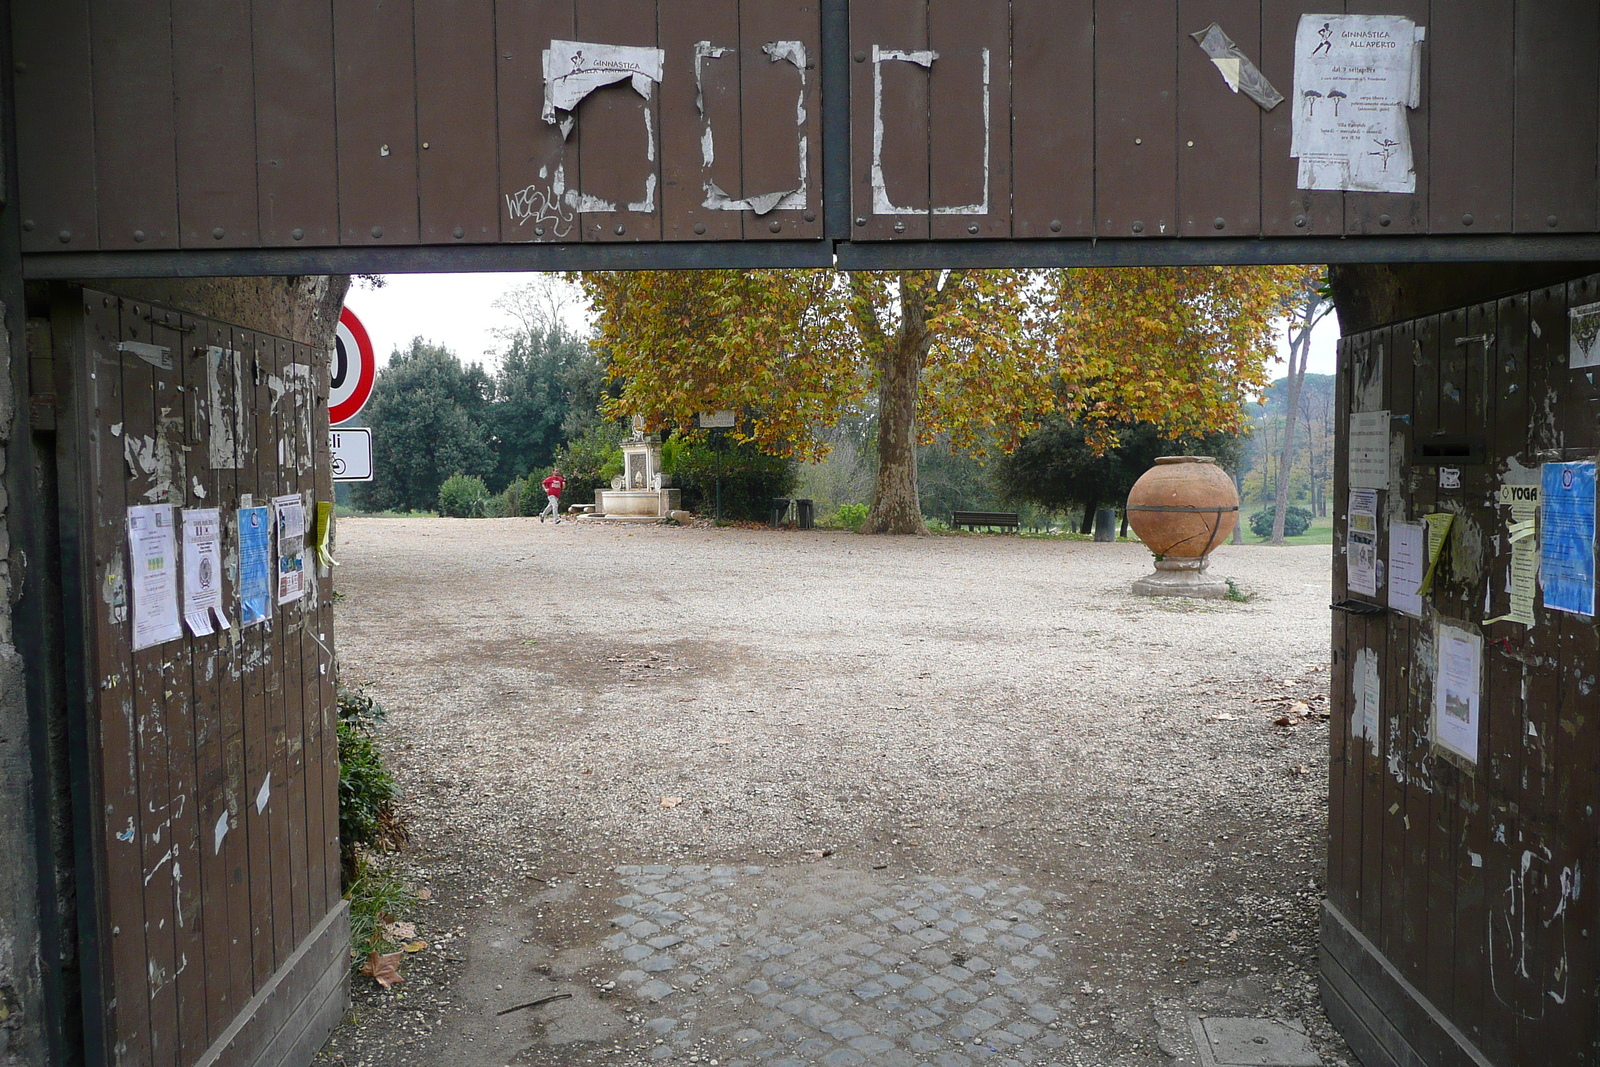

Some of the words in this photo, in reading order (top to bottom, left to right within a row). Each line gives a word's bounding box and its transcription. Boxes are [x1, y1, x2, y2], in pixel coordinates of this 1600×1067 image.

[1341, 30, 1390, 38] GINNASTICA
[593, 60, 640, 69] GINNASTICA
[1511, 487, 1538, 502] YOGA
